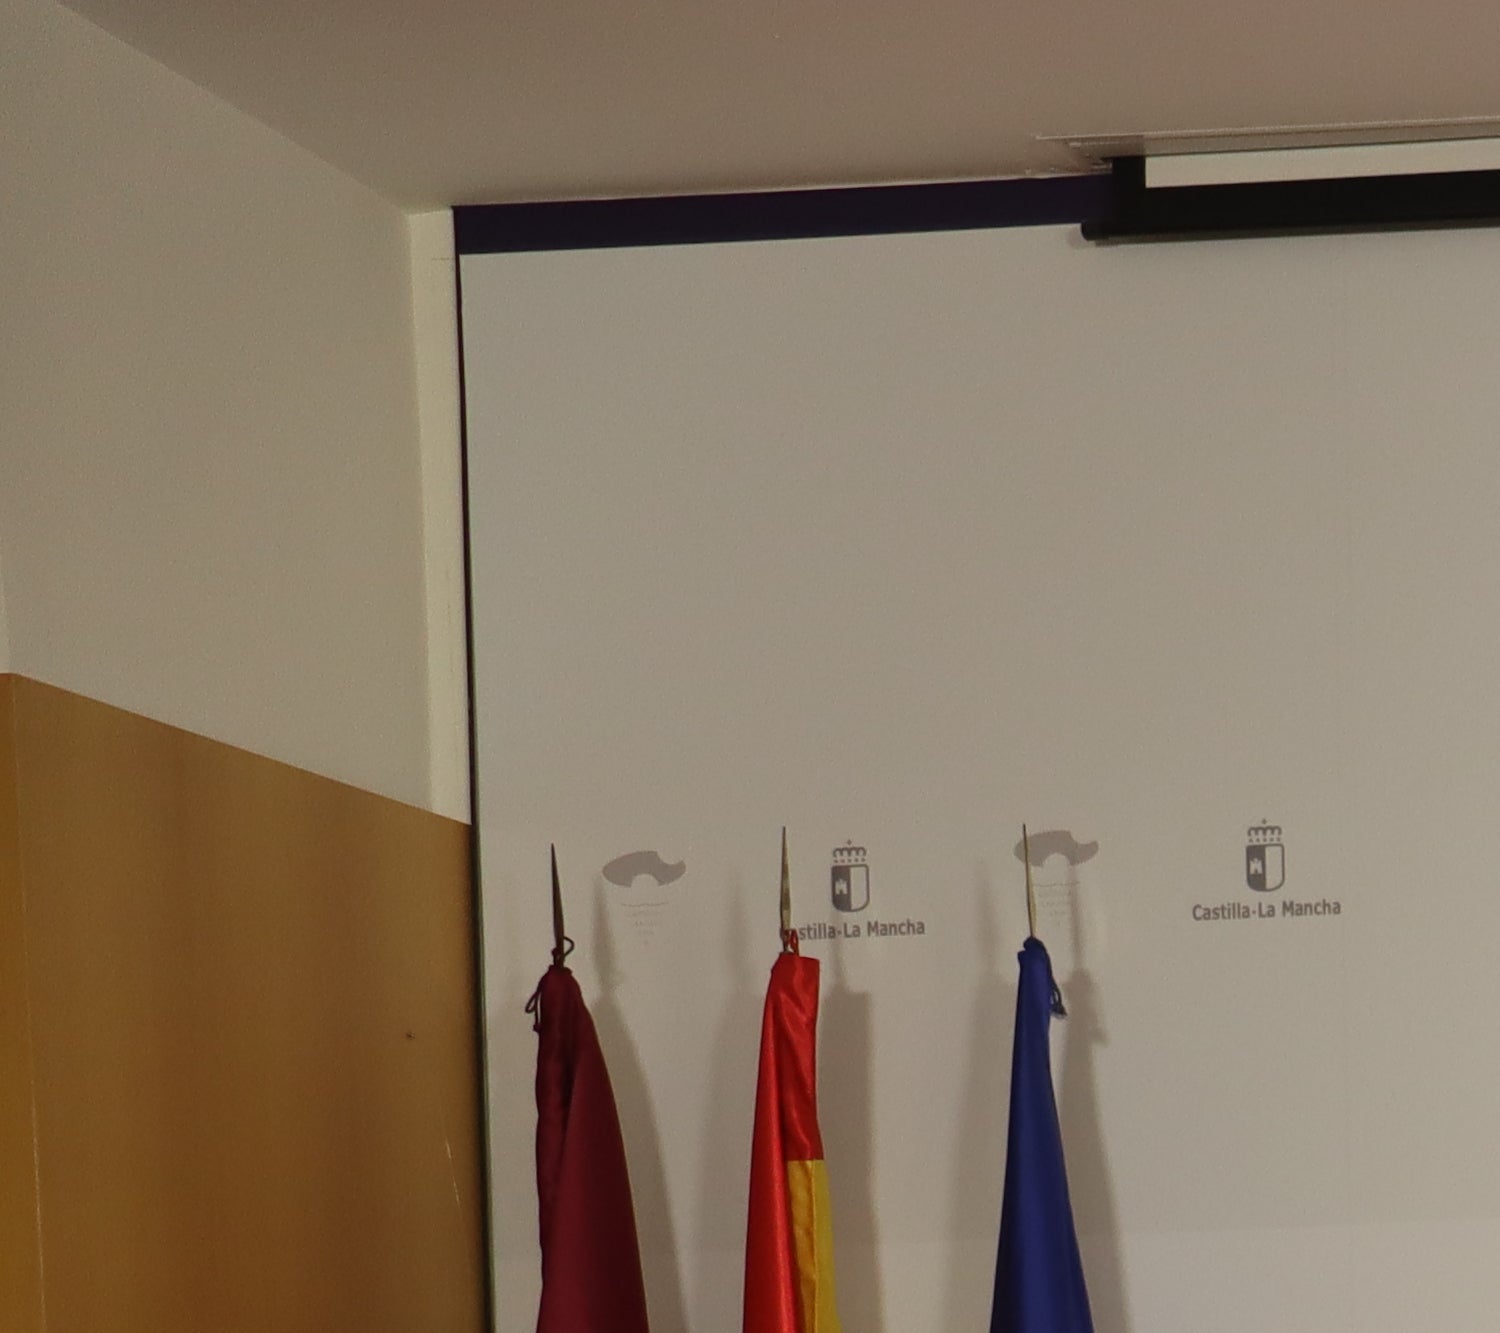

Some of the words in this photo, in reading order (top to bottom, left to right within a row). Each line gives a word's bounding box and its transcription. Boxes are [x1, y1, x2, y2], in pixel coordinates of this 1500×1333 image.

[1192, 901, 1276, 922] Castilla-La
[1281, 898, 1342, 918] Mancha
[799, 922, 861, 940] stilla-La
[867, 918, 926, 937] Mancha
